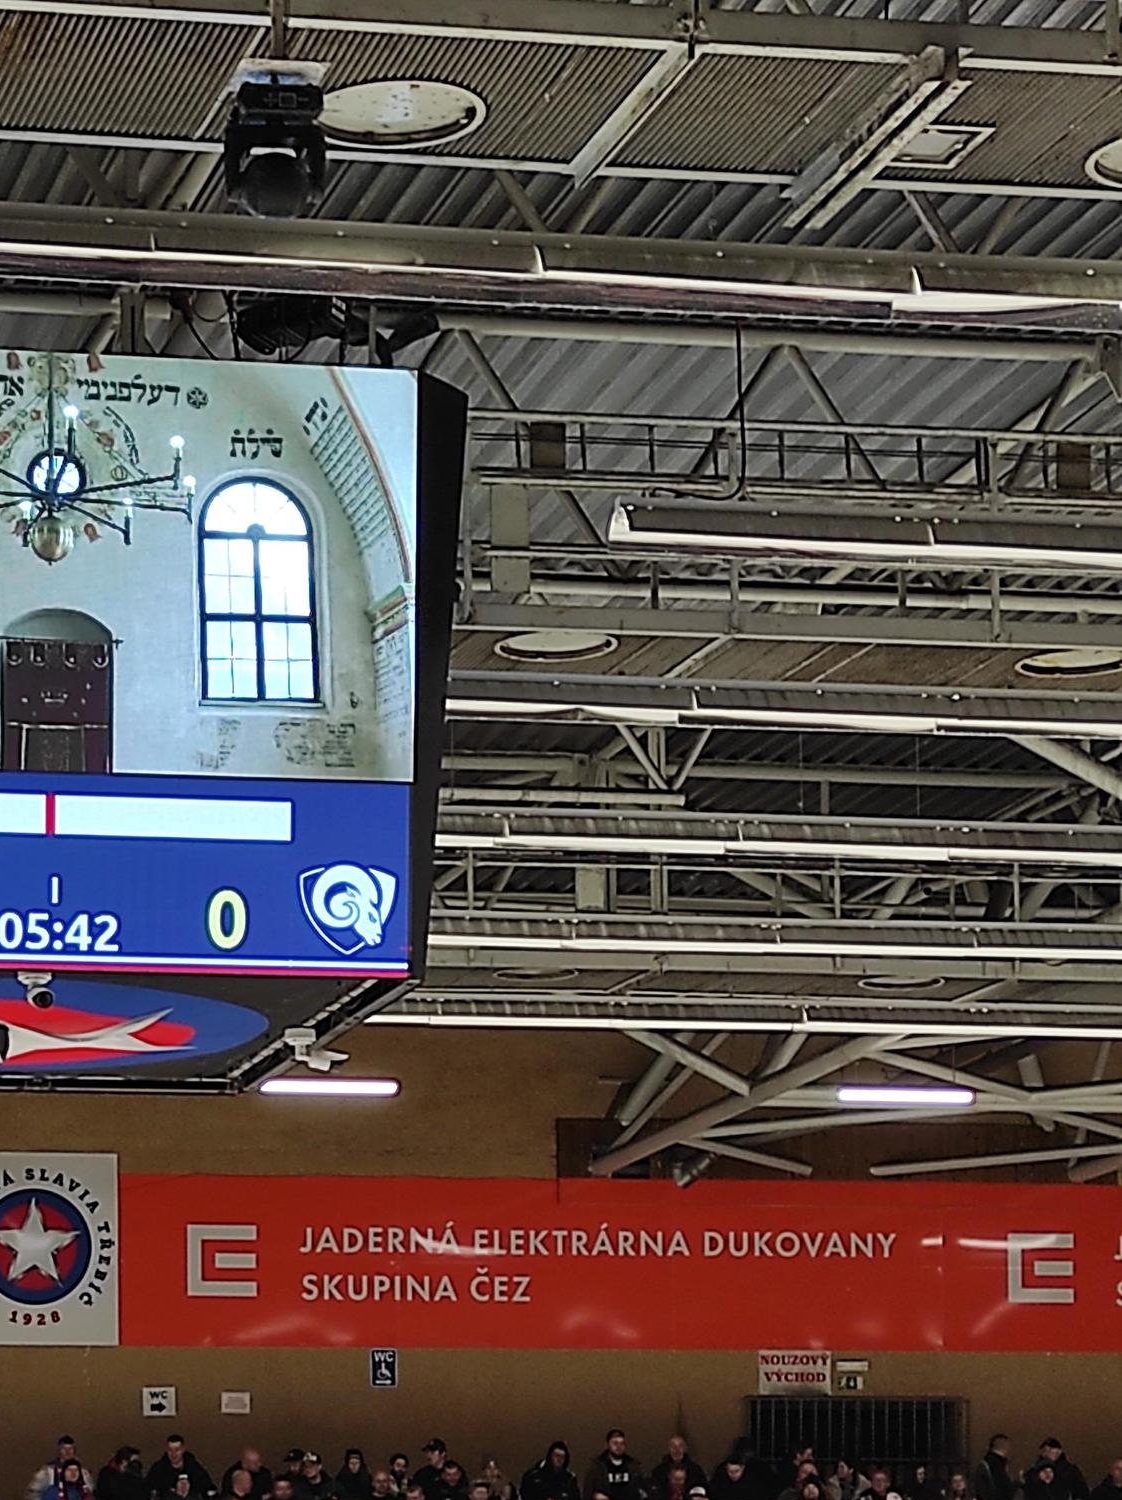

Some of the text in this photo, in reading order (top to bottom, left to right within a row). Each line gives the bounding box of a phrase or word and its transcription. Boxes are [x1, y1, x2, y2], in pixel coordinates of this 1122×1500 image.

[208, 889, 246, 949] 0
[25, 1168, 99, 1214] SLAVIA
[299, 1221, 897, 1258] JADERNÁ ELEKTRÁRNA DUKOVANY
[301, 1267, 531, 1302] SKUPINA ČEZ
[9, 1310, 61, 1326] 1928
[374, 1351, 394, 1363] WC
[760, 1353, 830, 1366] NOUZOVÝ
[764, 1369, 827, 1383] VÝCHOD
[149, 1390, 168, 1399] WC
